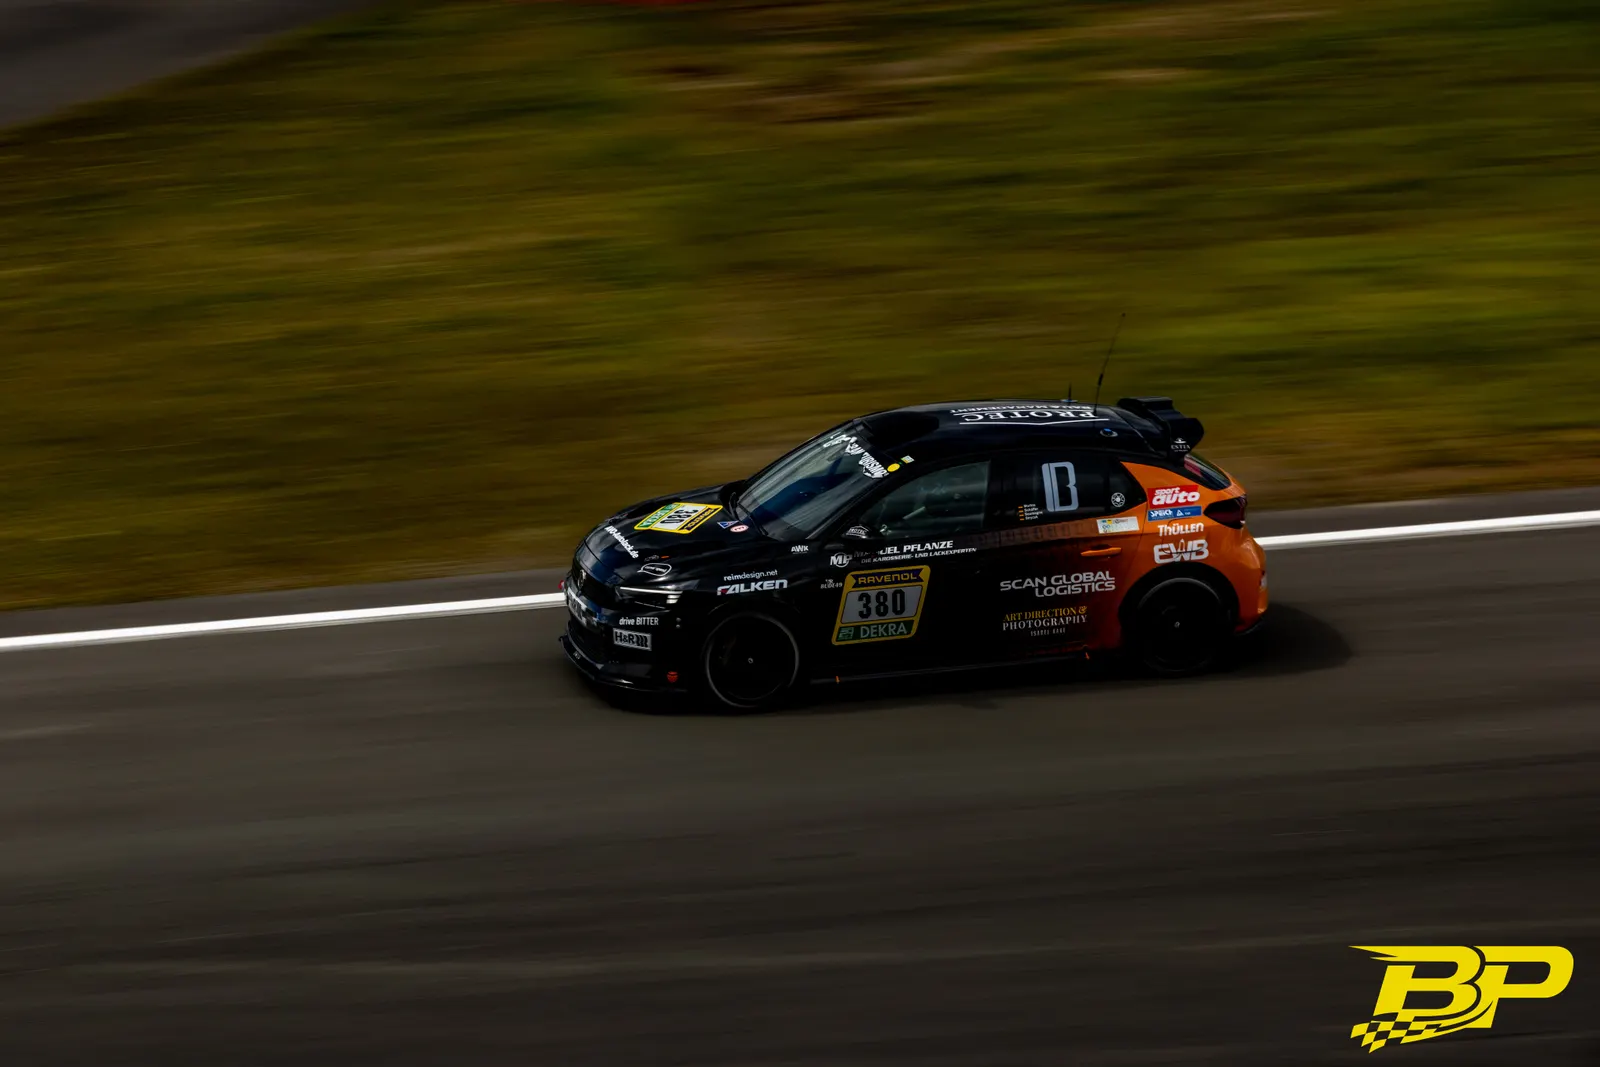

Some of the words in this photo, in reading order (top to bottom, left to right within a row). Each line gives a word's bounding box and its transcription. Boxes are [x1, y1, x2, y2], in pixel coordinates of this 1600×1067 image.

[962, 411, 1099, 422] PROTEC
[1151, 491, 1201, 505] auto
[1154, 487, 1181, 497] sport
[660, 509, 699, 524] 380
[903, 540, 954, 553] PFLANZE
[723, 569, 779, 581] reimdesign.net
[857, 571, 918, 585] RAVENOL
[1000, 576, 1048, 592] SCAN
[1050, 570, 1116, 586] GLOBAL
[717, 579, 788, 596] FALKEN
[1035, 581, 1116, 598] LOGISTICS
[857, 589, 905, 619] 380
[619, 616, 635, 626] drive
[635, 616, 660, 626] BITTER
[1003, 612, 1024, 622] ART
[1024, 607, 1077, 620] DIRECTION
[1002, 614, 1088, 631] PHOTOGRAPHY
[859, 622, 908, 639] DEKRA
[614, 631, 635, 645] H&R
